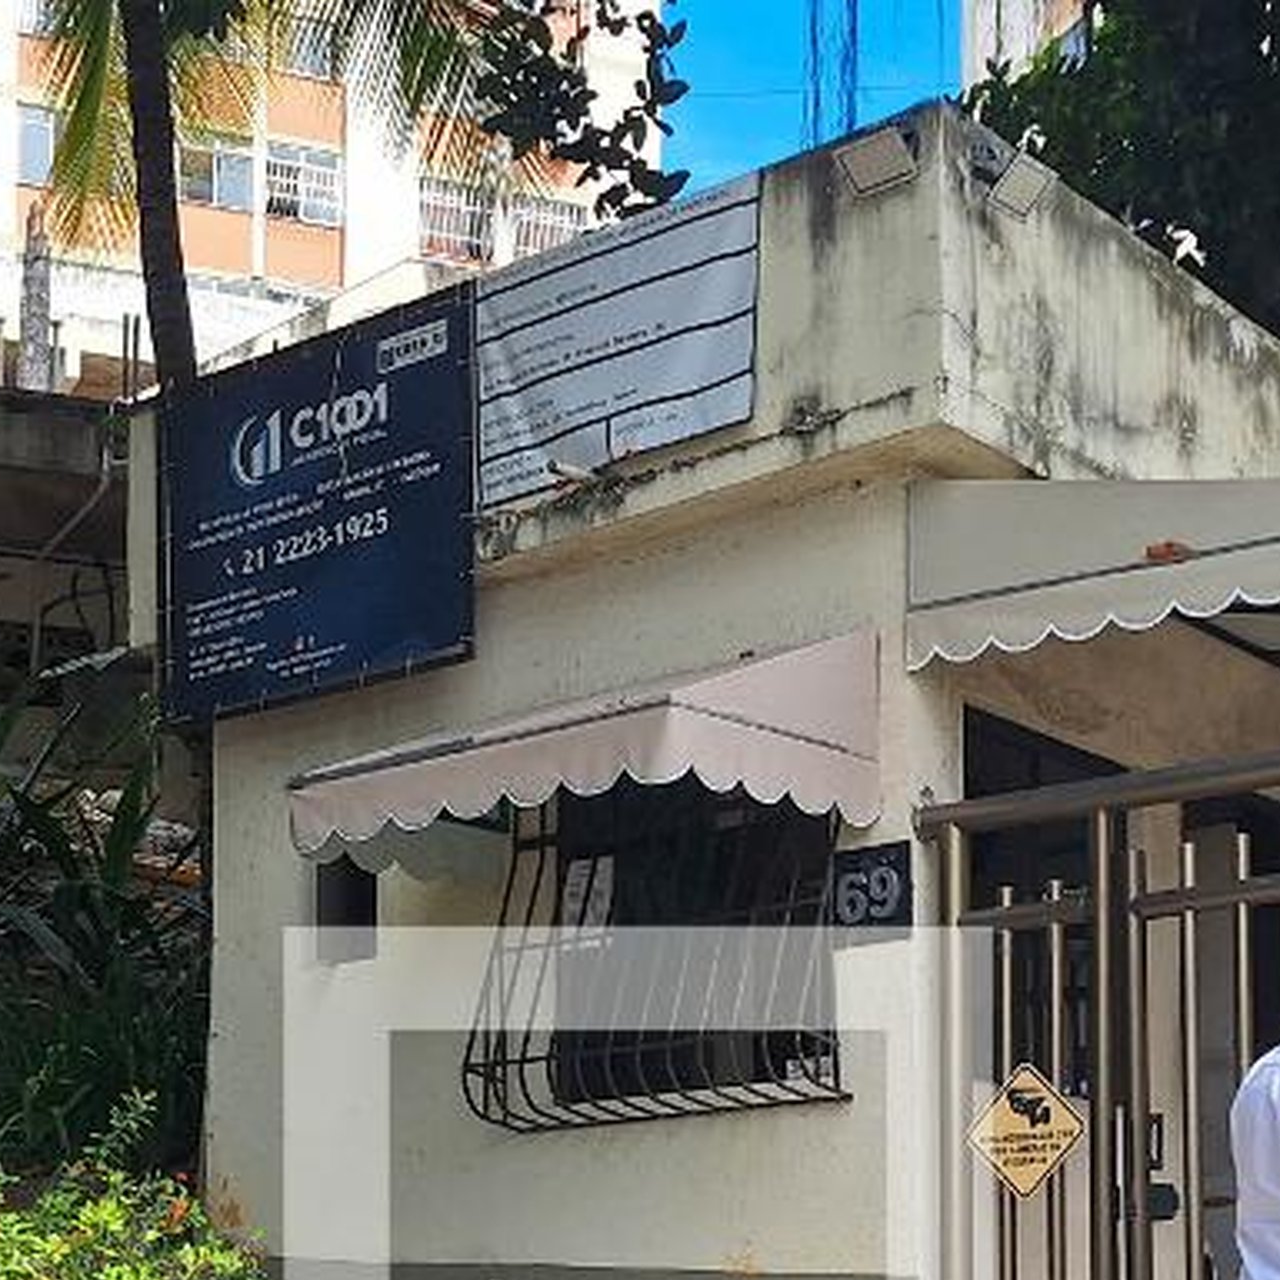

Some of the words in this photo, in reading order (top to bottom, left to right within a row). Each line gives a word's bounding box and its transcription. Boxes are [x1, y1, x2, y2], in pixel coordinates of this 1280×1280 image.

[241, 546, 265, 574] 21
[272, 507, 390, 565] 2223-1925
[837, 866, 900, 925] 69
